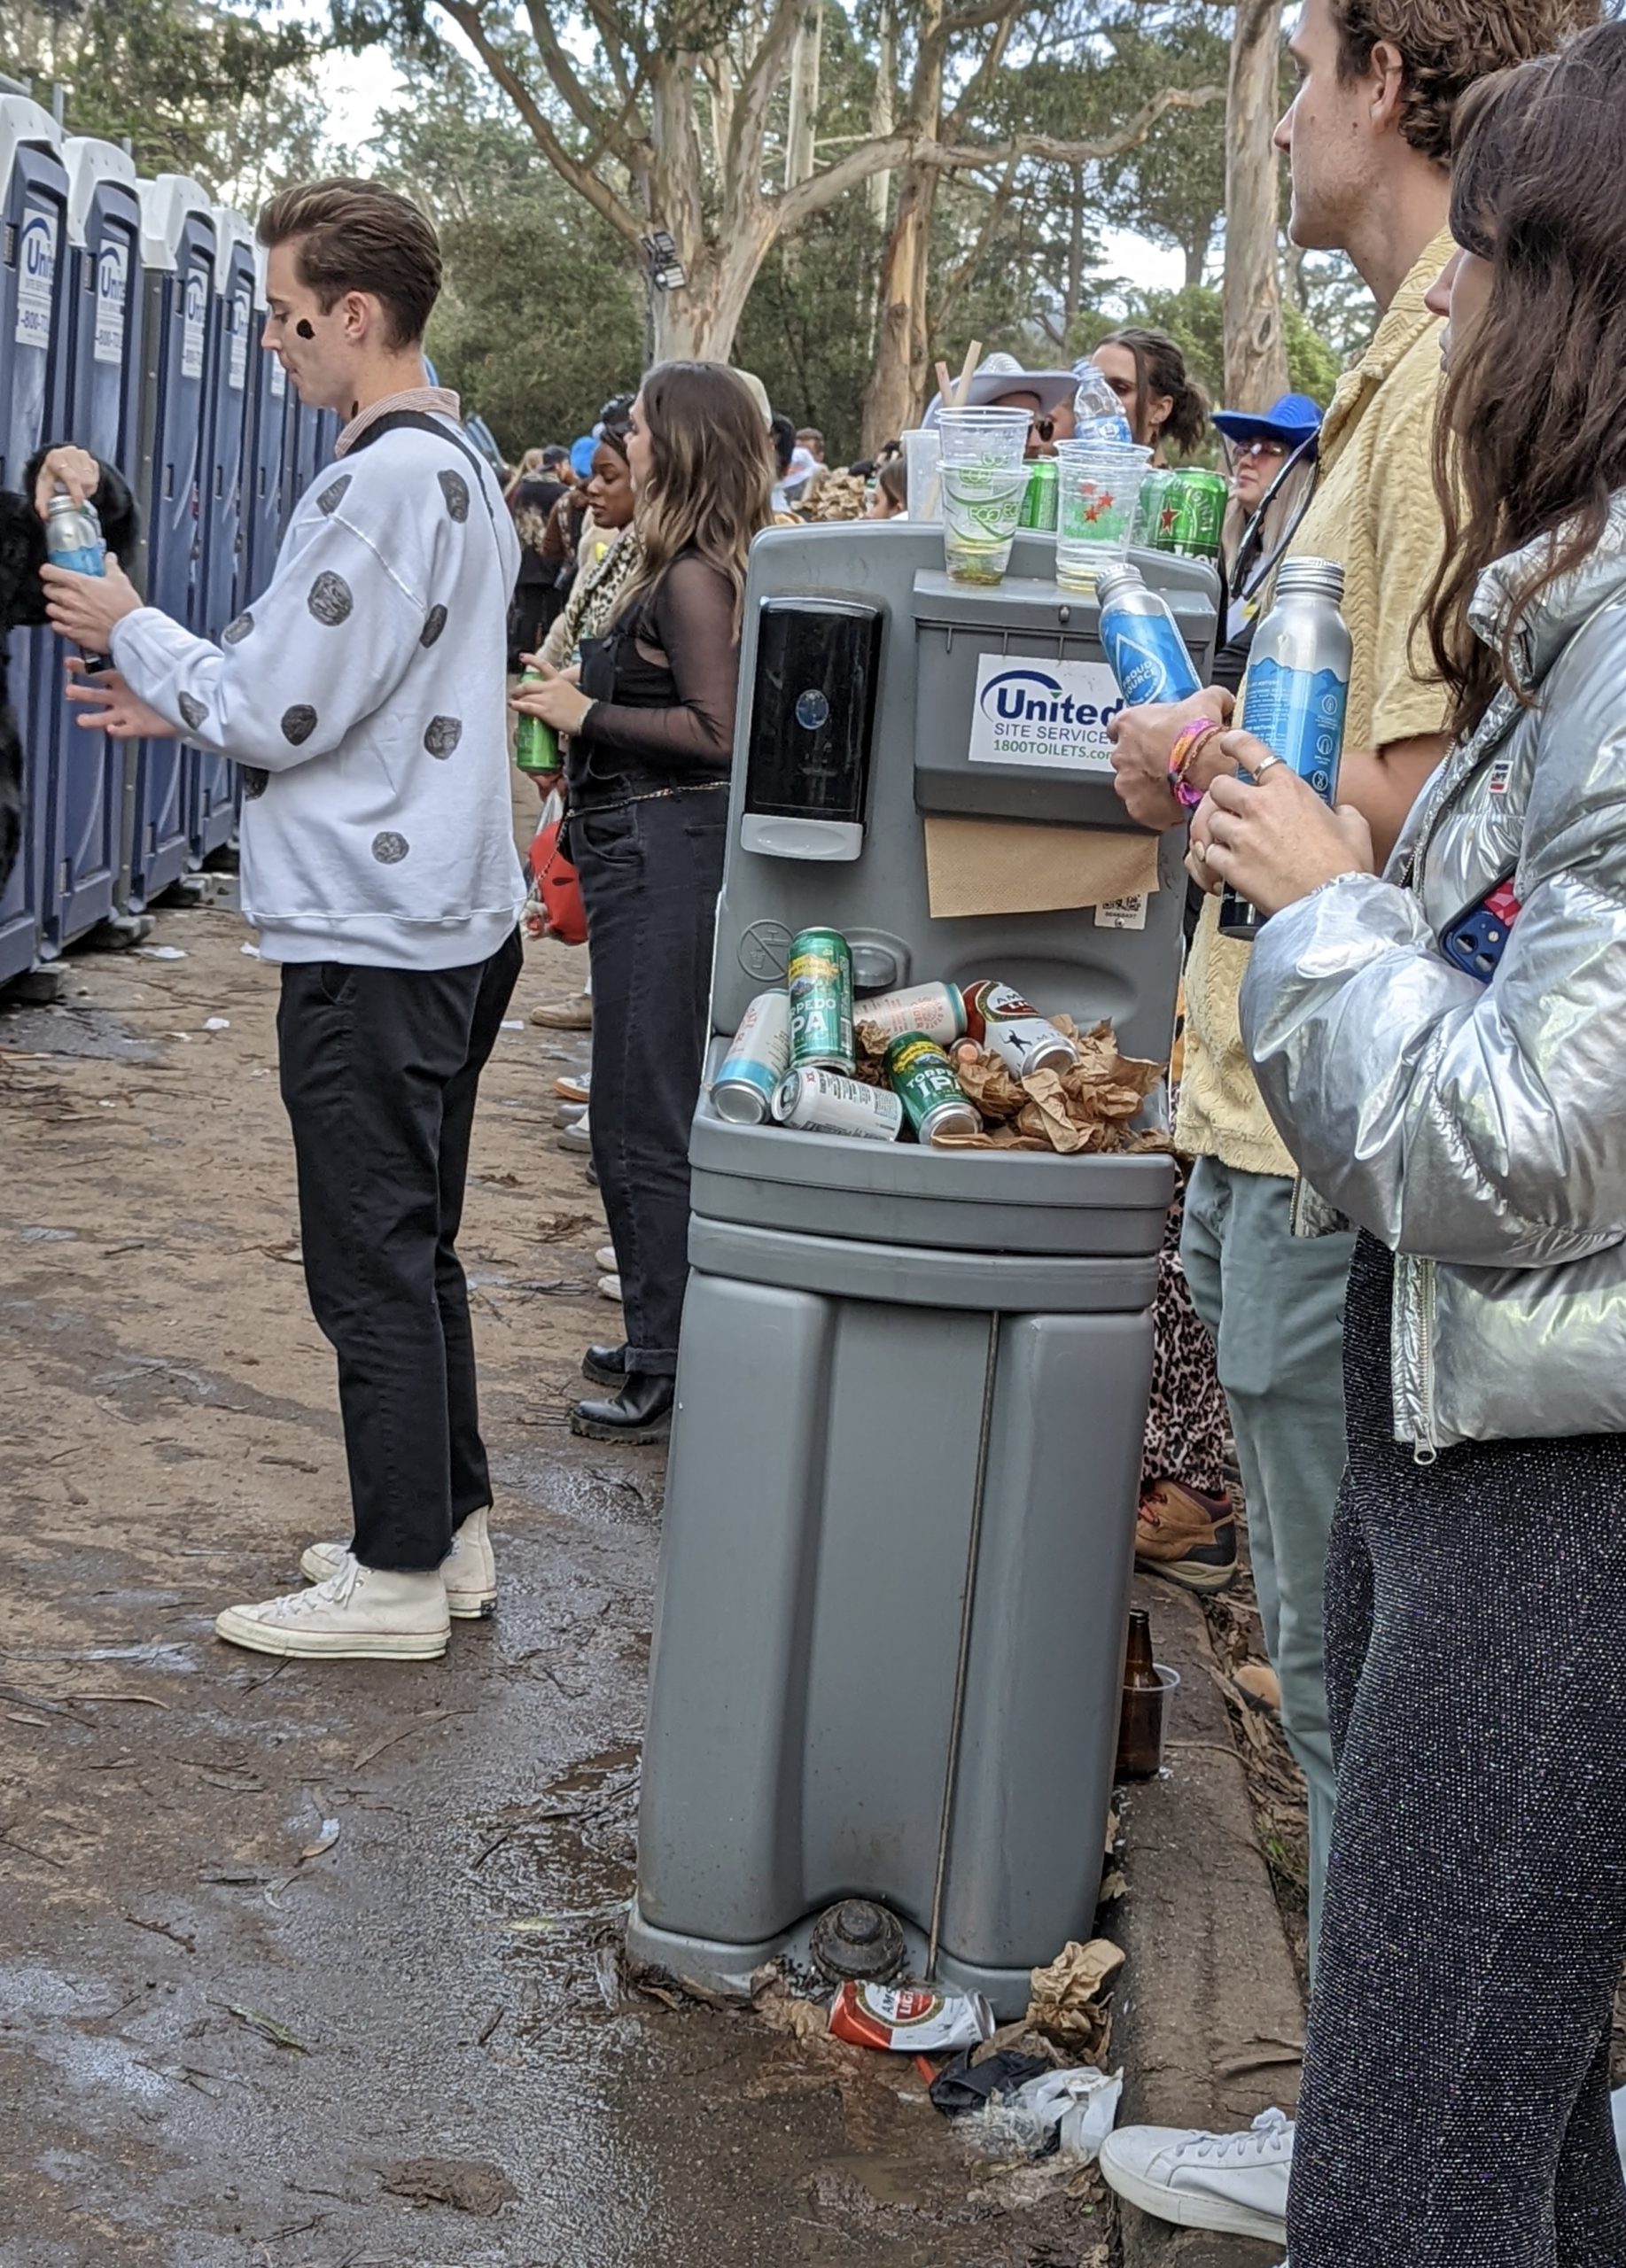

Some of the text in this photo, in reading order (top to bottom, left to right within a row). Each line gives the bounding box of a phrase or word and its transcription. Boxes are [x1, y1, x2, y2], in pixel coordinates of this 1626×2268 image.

[997, 687, 1124, 727] United
[994, 723, 1114, 744] SITE SERVICE
